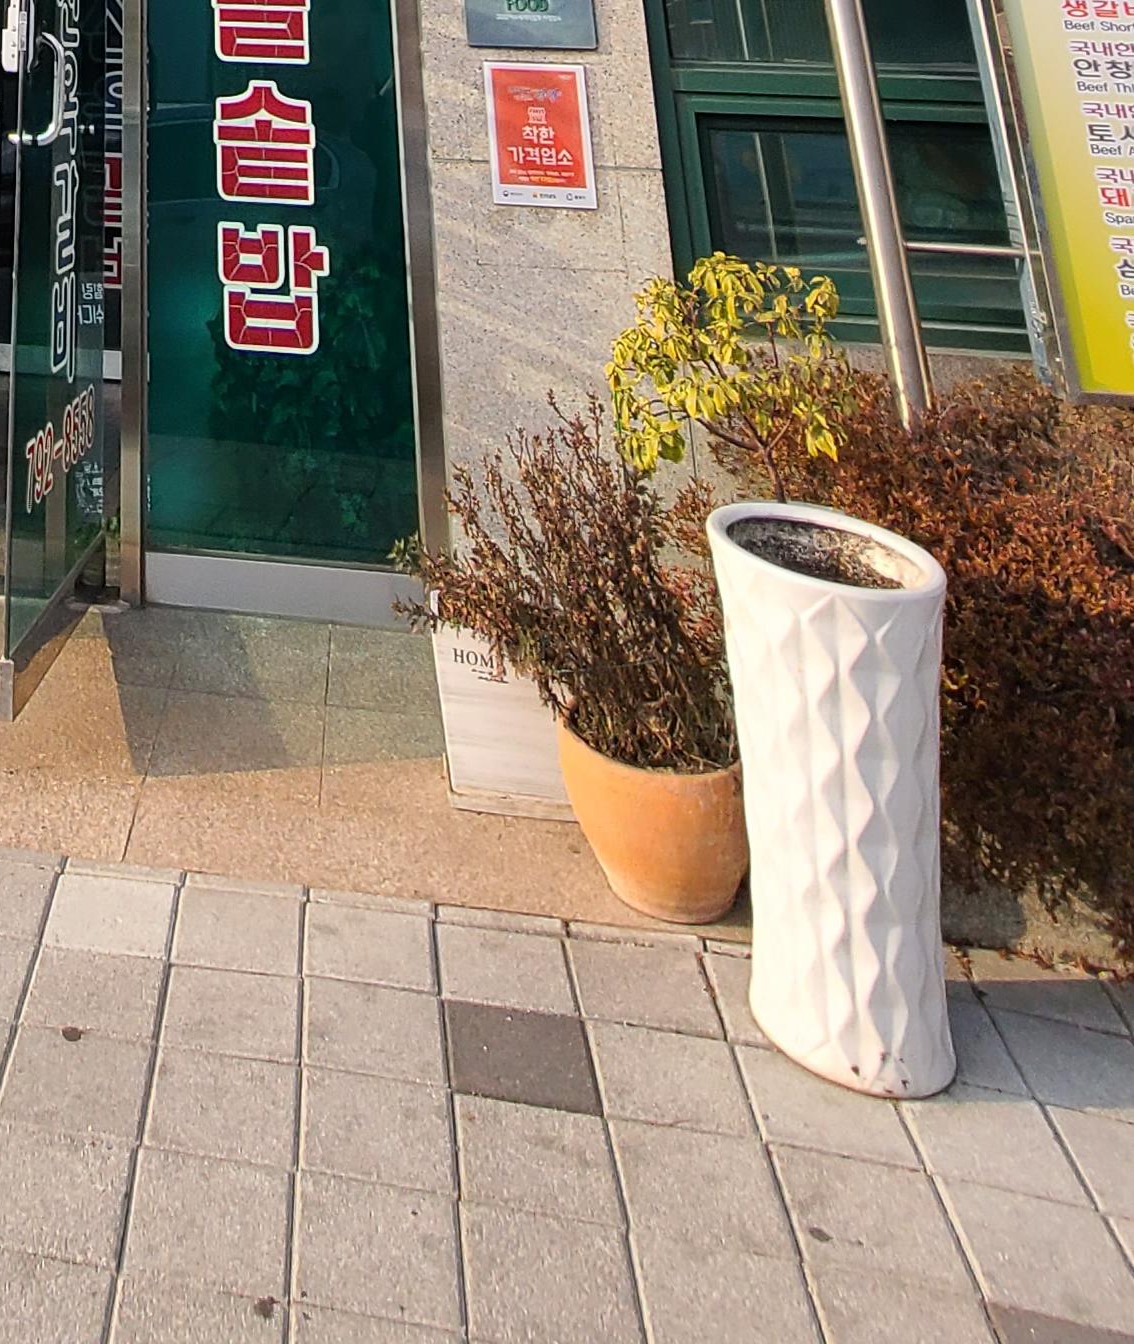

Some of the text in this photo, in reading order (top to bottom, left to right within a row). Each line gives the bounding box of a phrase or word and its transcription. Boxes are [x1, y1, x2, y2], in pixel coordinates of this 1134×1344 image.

[1063, 19, 1096, 31] Beef
[1076, 81, 1108, 92] Beef
[522, 125, 555, 145] 착한
[507, 146, 574, 167] 가격업소
[1089, 144, 1122, 155] Beef
[25, 384, 95, 514] 792-8558
[453, 648, 503, 669] HOM
